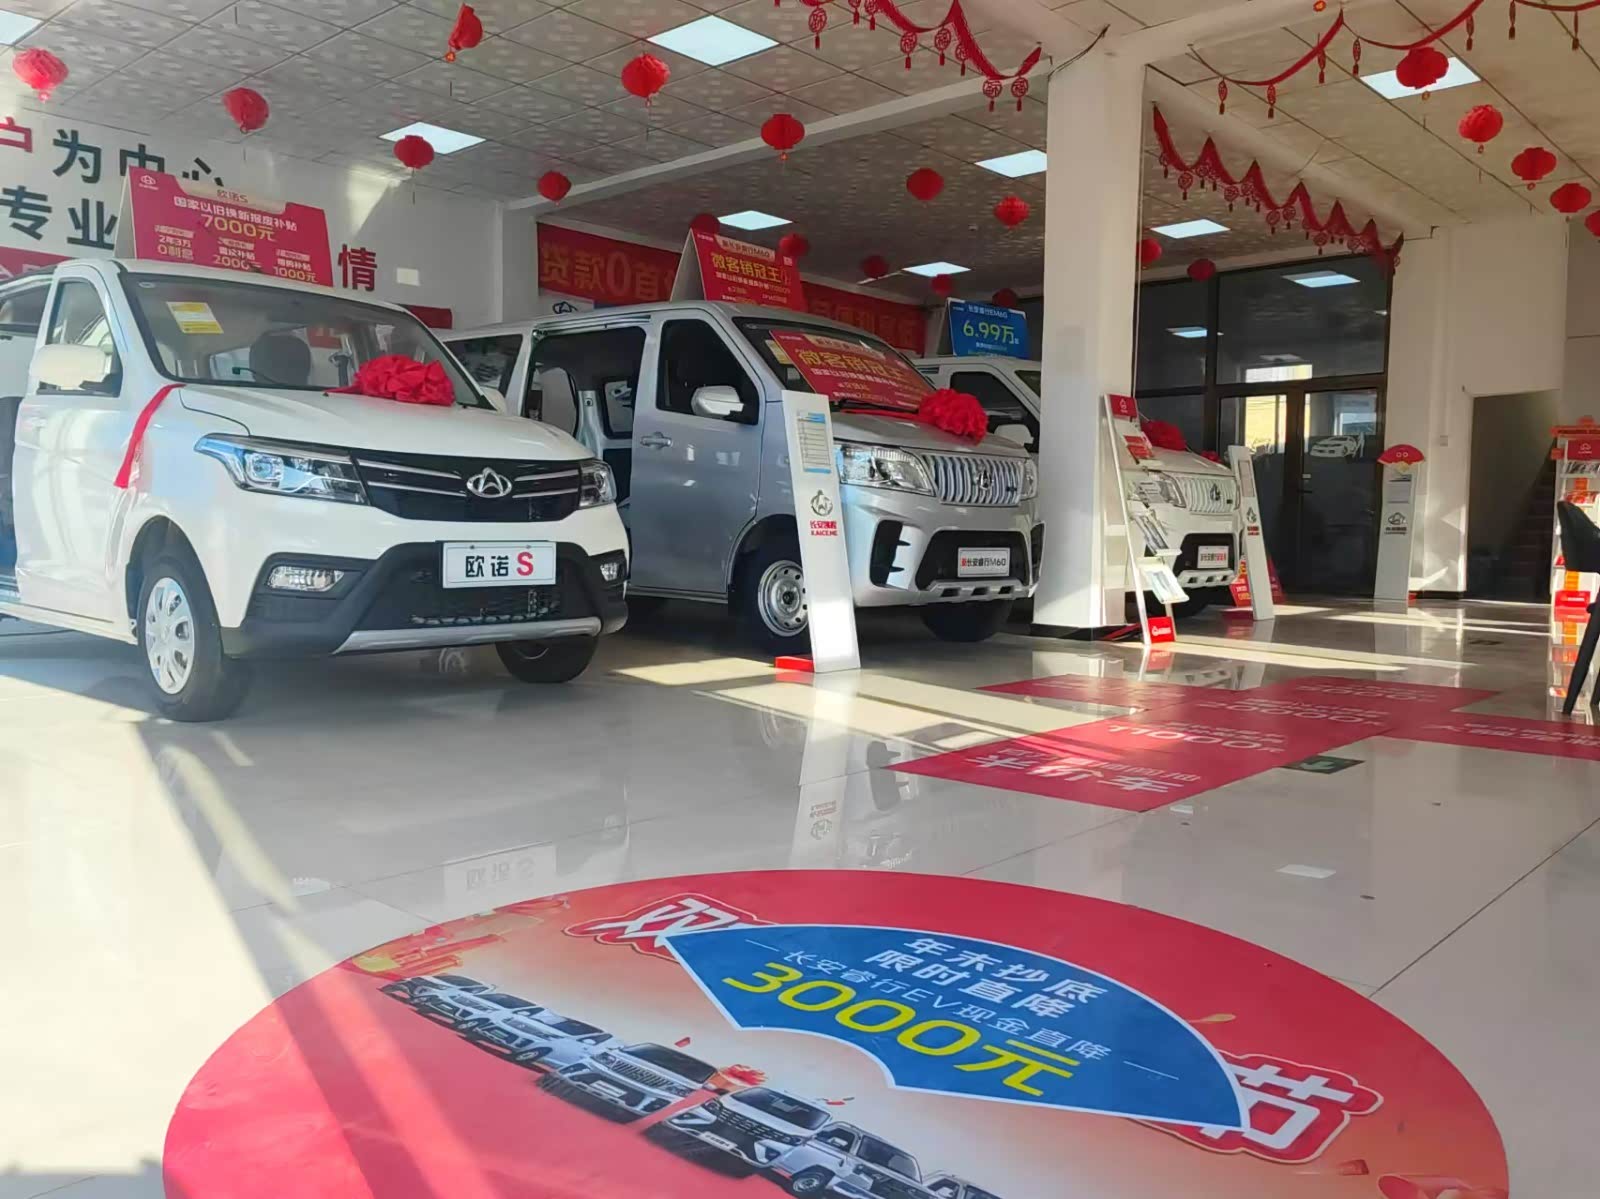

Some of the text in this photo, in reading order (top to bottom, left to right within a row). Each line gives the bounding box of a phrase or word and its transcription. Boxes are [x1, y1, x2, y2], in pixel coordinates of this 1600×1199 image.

[200, 213, 277, 242] 7000元
[337, 243, 378, 292] 情
[465, 551, 534, 578] 欧诺S
[964, 755, 1185, 793] 半价车
[864, 950, 1076, 1019] 限时直降
[903, 937, 1108, 1004] 年末抄底
[721, 962, 1081, 1097] 3000元
